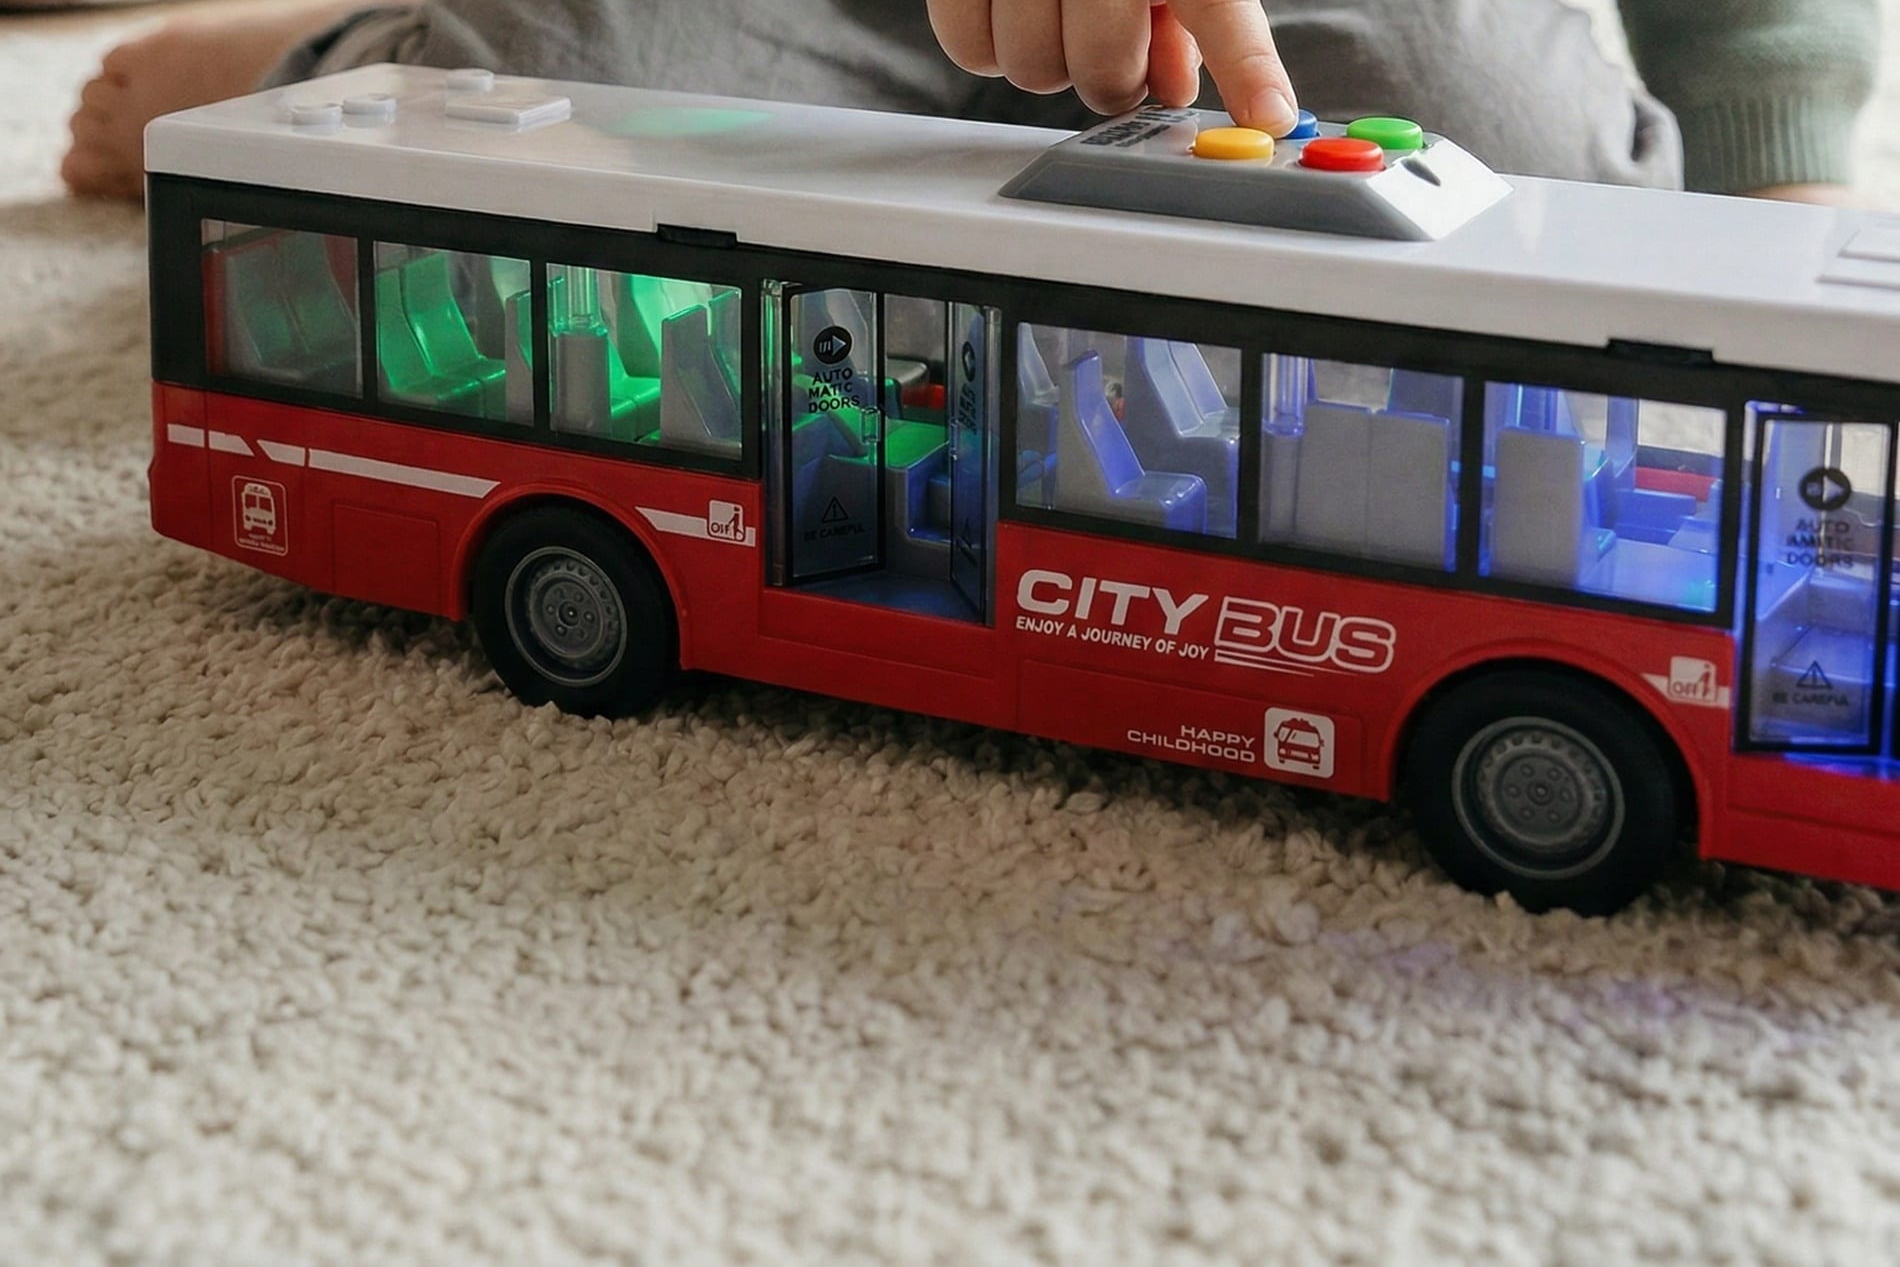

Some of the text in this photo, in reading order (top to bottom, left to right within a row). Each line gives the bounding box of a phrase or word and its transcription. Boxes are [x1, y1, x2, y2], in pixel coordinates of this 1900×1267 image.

[812, 367, 853, 385] AUTO
[808, 381, 853, 399] MATIC
[808, 394, 860, 413] DOORS
[1016, 569, 1396, 673] CITY BUS
[1016, 616, 1209, 660] ENJOY A JOURNEY OF JOY
[1127, 730, 1255, 762] CHILDHOOD
[1181, 725, 1255, 748] HAPPY
